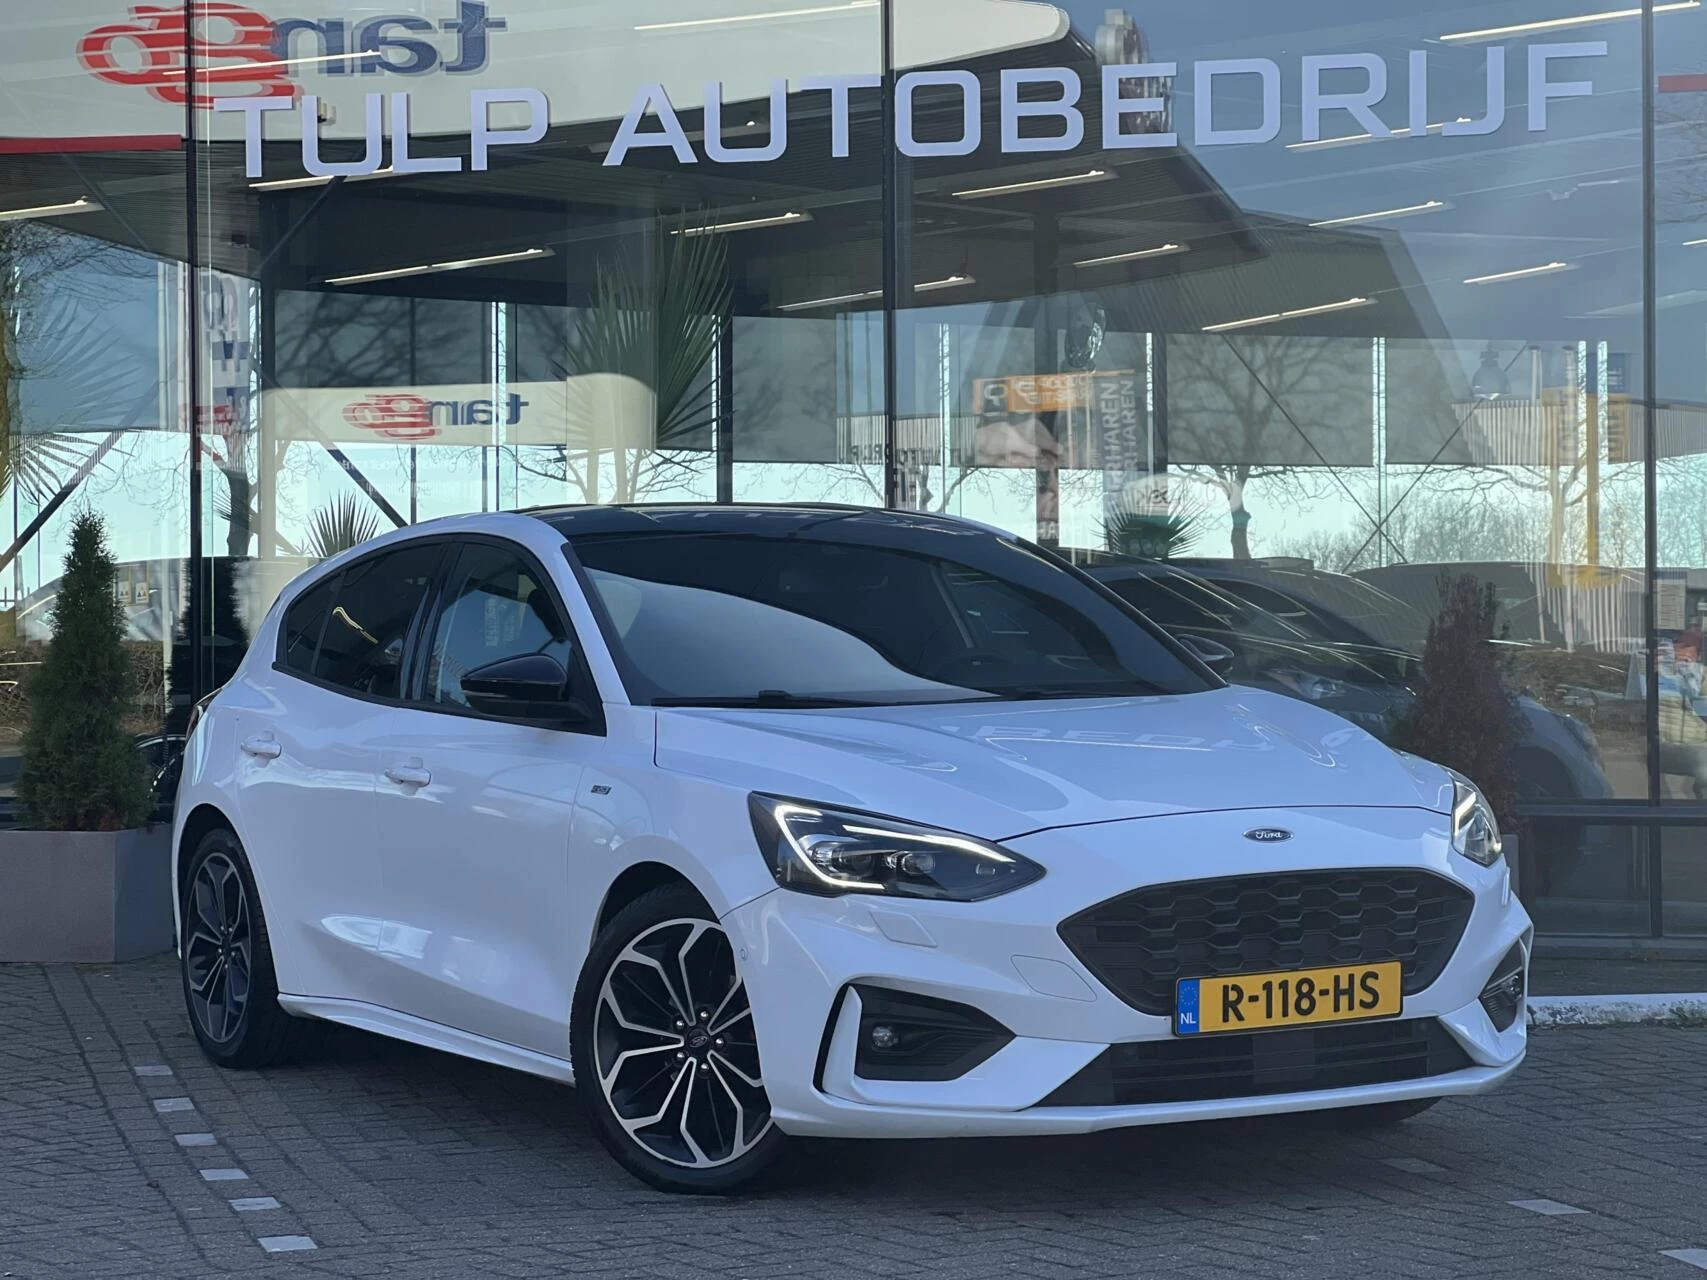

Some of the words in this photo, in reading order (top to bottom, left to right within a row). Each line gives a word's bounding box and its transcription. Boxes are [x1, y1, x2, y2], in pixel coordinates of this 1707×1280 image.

[213, 87, 549, 178] TULP
[602, 41, 1608, 167] AUTOBEDRIJF
[1180, 1011, 1197, 1025] NL
[1221, 970, 1380, 1024] R-118-HS
